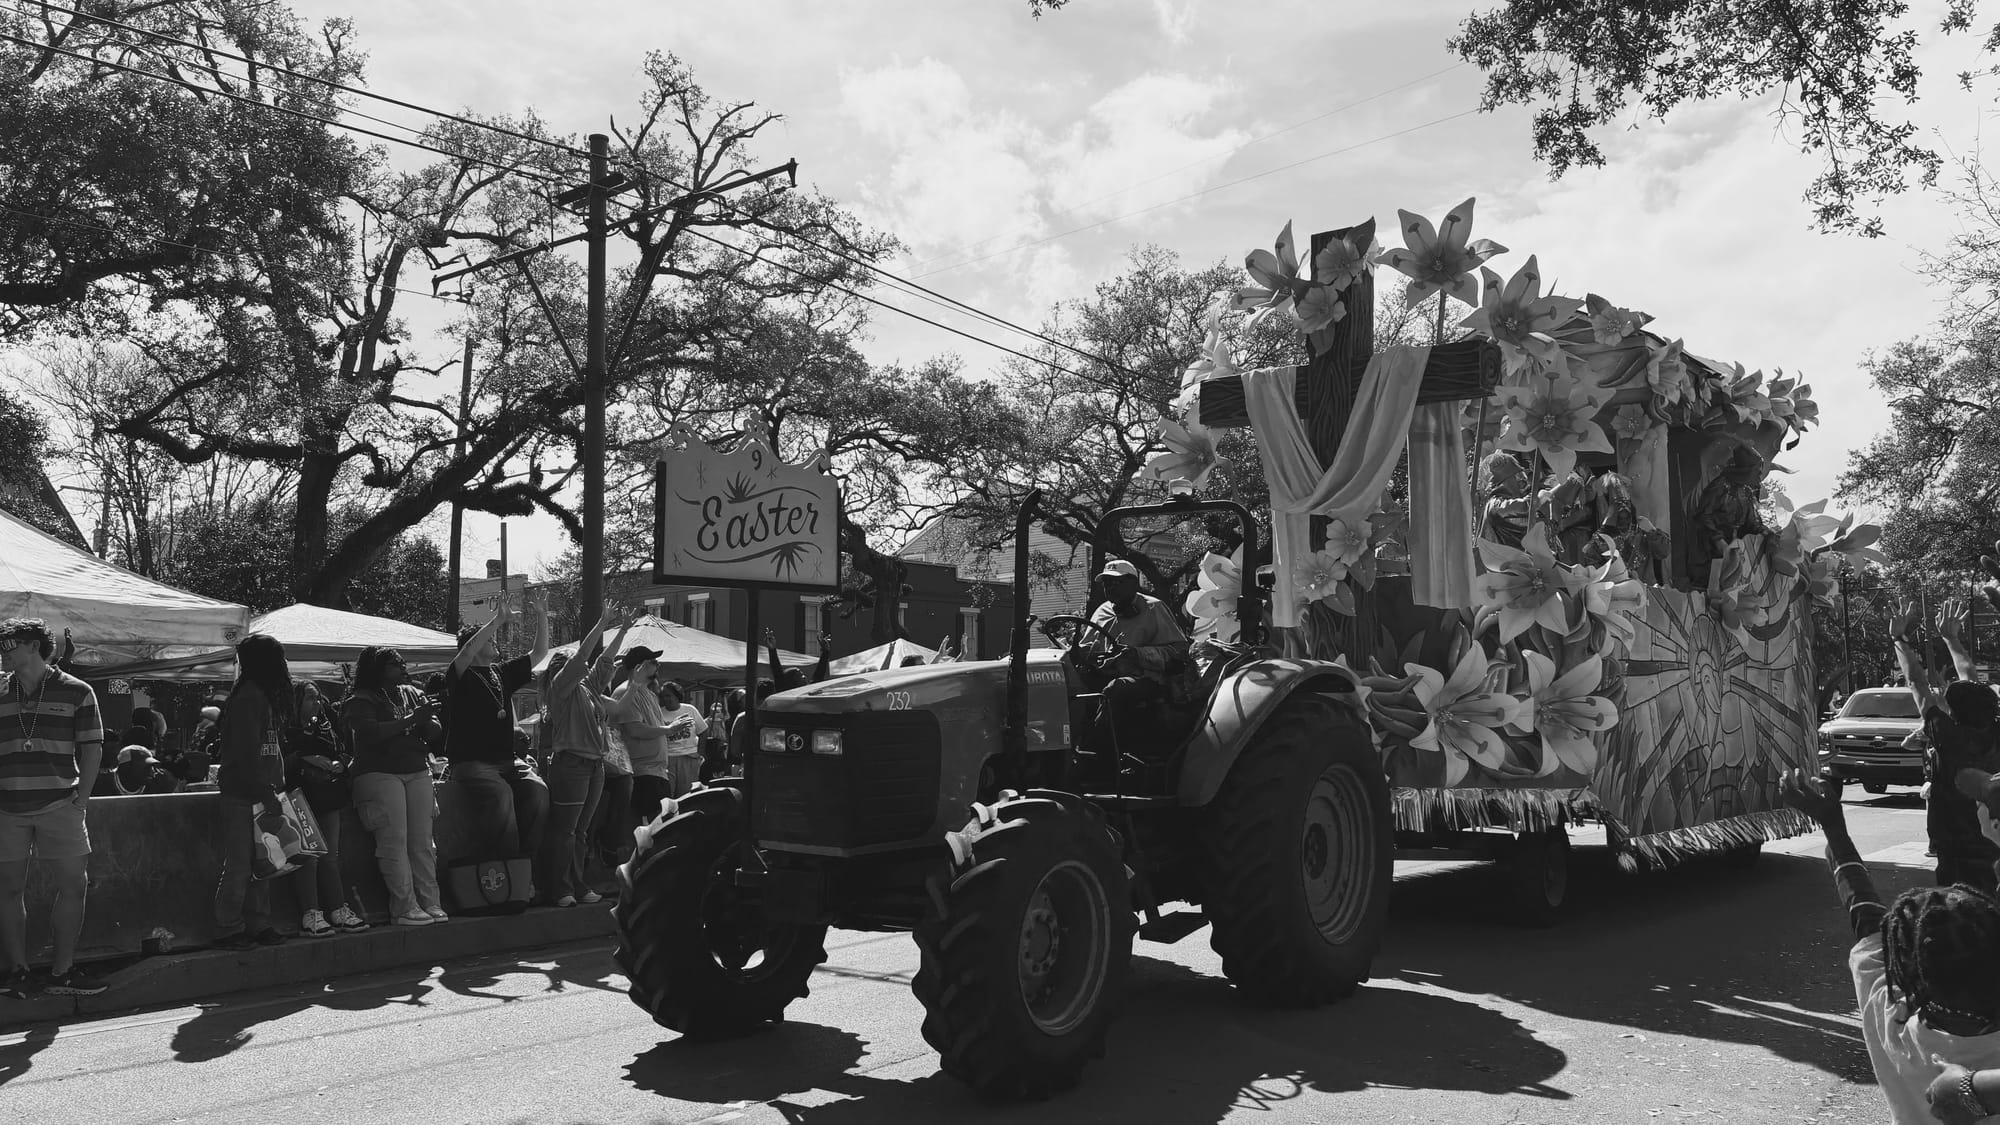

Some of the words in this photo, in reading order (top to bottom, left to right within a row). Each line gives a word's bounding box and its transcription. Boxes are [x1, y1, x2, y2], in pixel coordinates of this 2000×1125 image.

[751, 450, 762, 470] 9
[697, 493, 819, 551] Easter
[1026, 671, 1064, 684] UBOTA
[886, 691, 912, 710] 232
